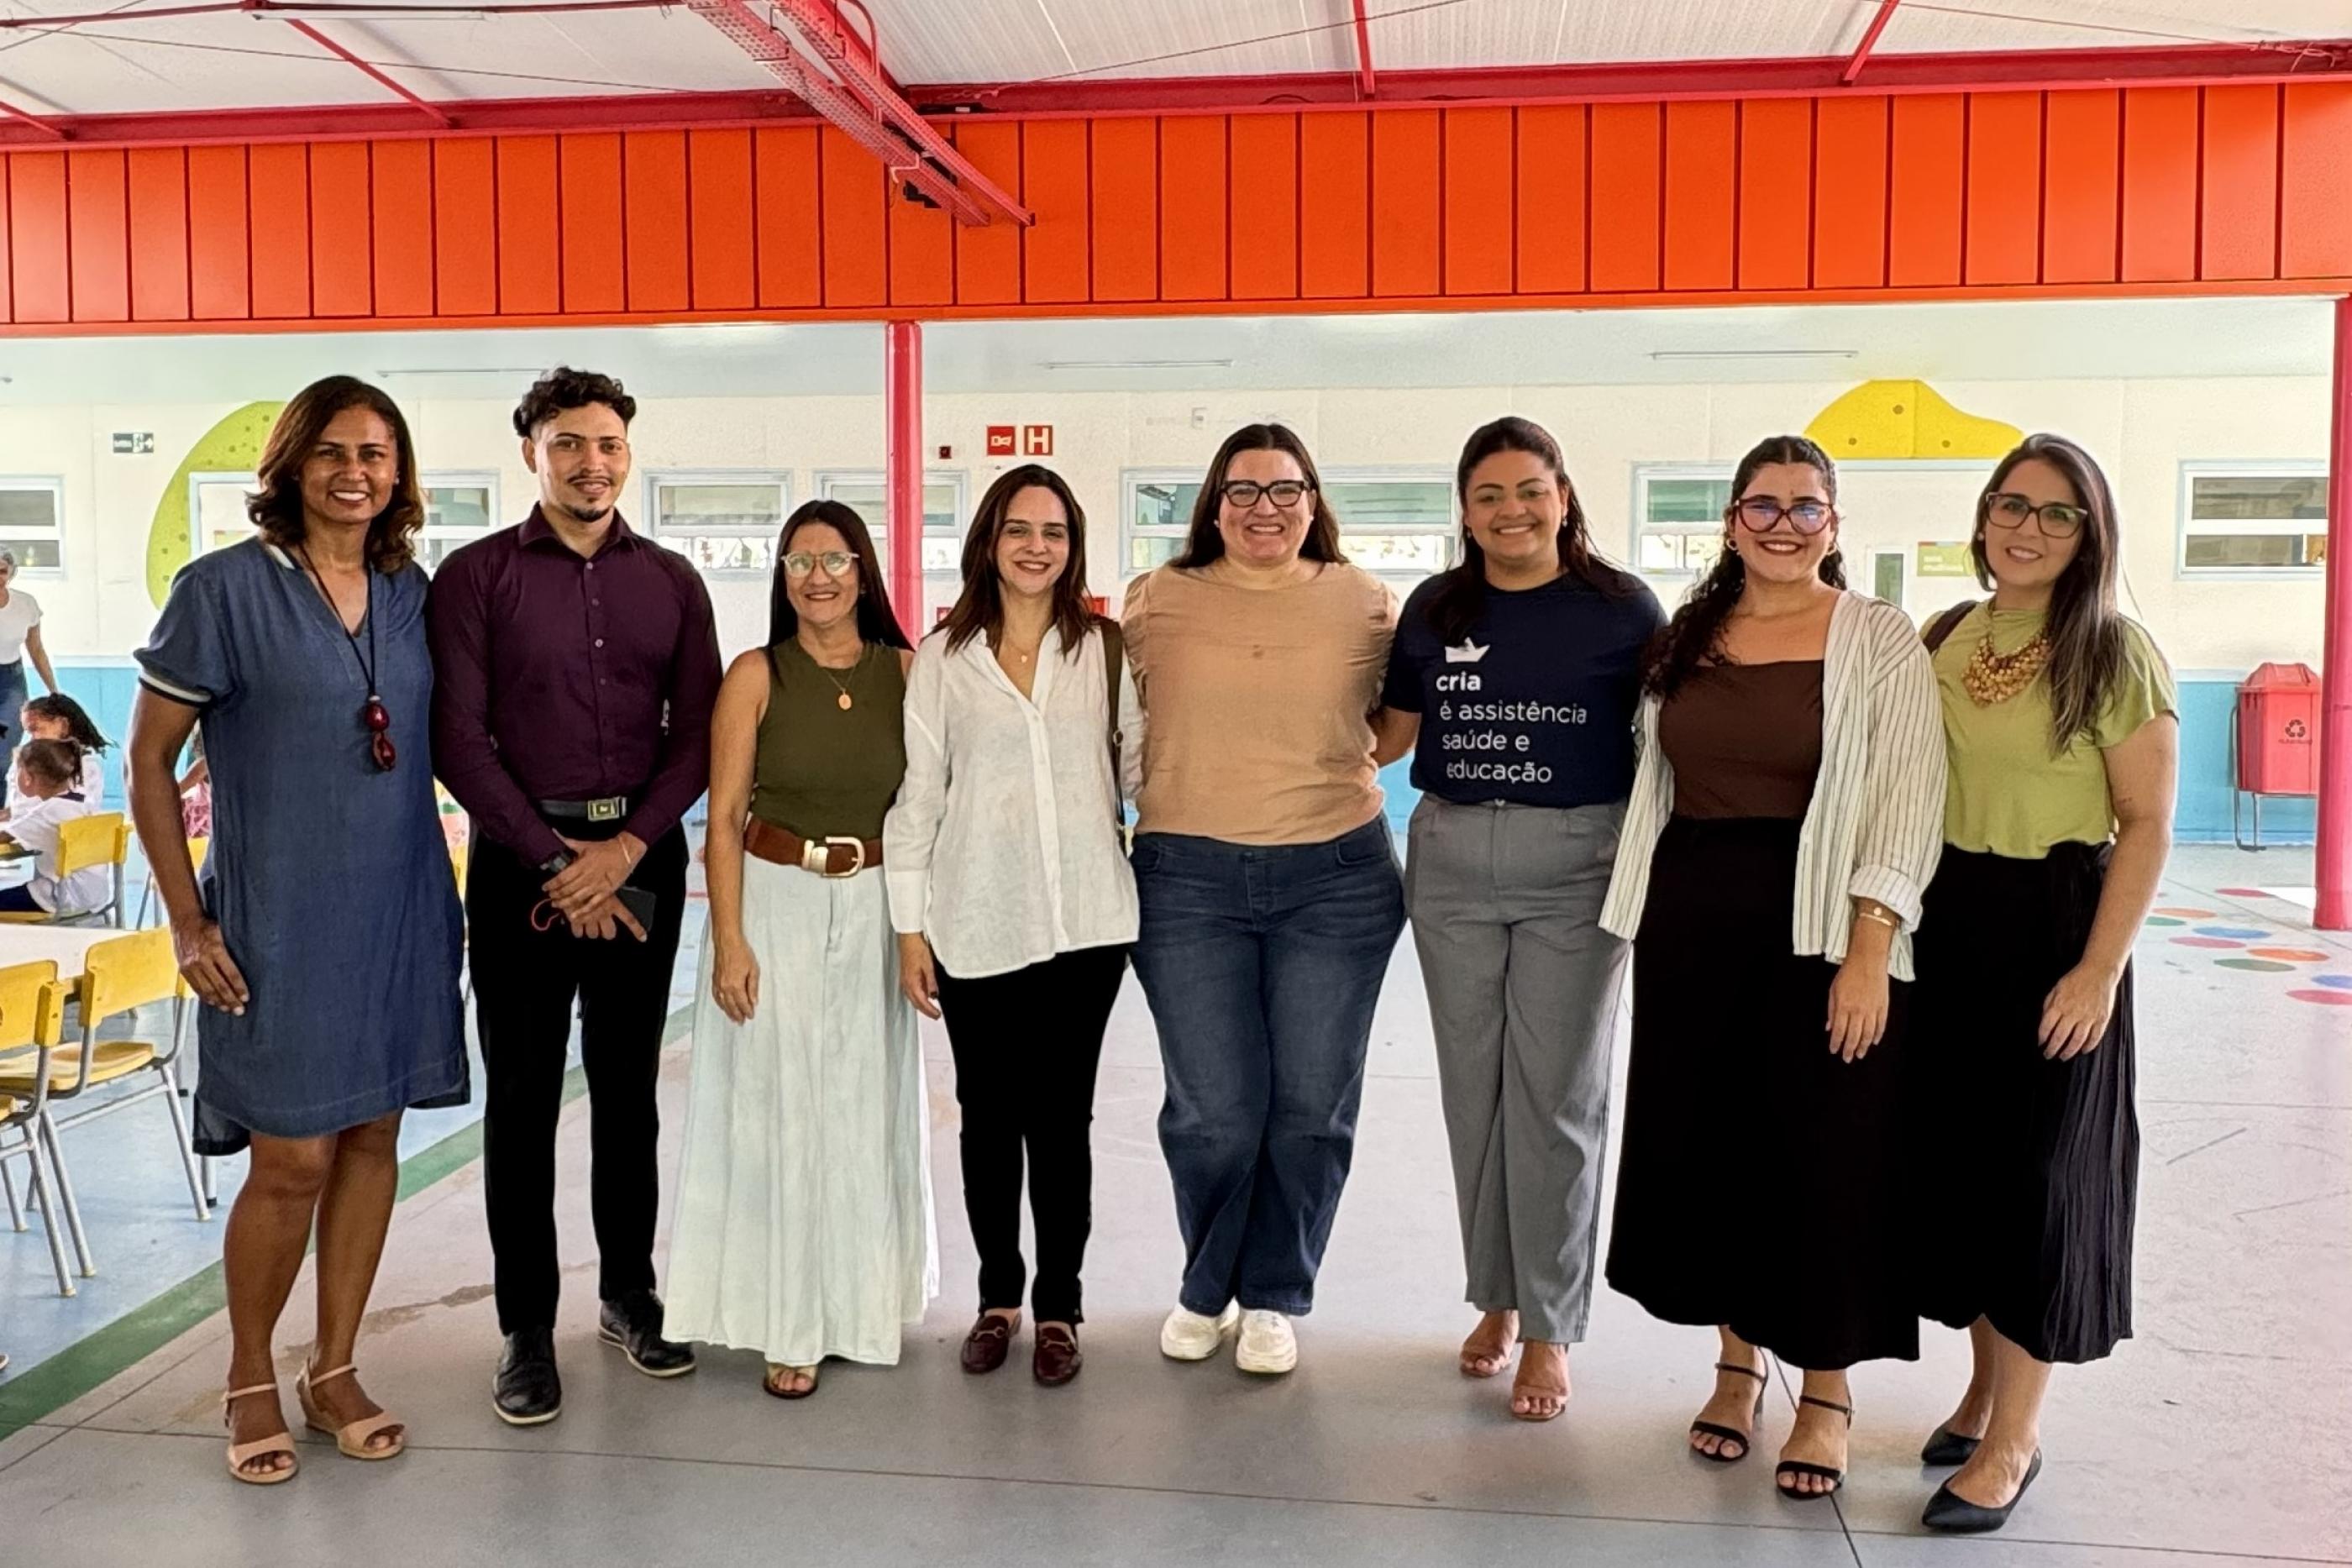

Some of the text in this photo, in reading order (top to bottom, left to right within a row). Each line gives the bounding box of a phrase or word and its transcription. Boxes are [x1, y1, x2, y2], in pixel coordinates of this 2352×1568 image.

[1027, 427, 1049, 454] H
[1436, 671, 1482, 691] cria
[1439, 700, 1588, 724] é assistência
[1442, 729, 1530, 752] saúde e
[1446, 758, 1552, 784] educação
